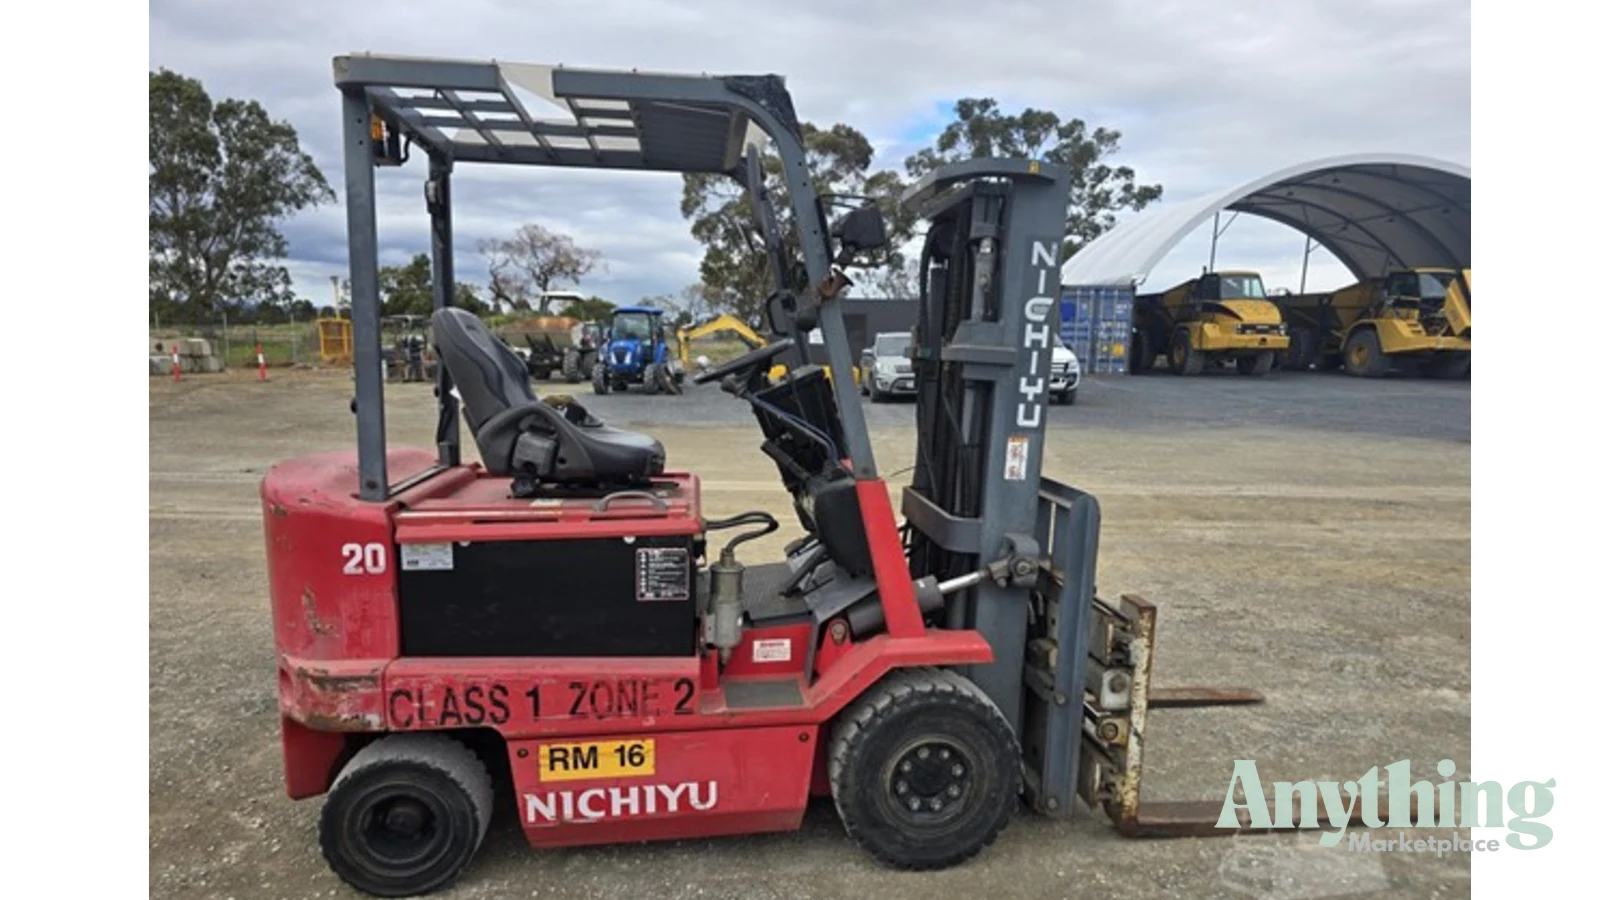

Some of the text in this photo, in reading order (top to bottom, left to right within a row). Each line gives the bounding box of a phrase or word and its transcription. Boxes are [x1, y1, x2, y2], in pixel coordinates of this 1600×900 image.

[1017, 241, 1058, 427] NICHIYU
[341, 543, 386, 575] 20
[389, 678, 695, 728] CLASS 1 ZONE 2
[548, 744, 645, 772] RM 16
[524, 781, 718, 824] NICHIYU
